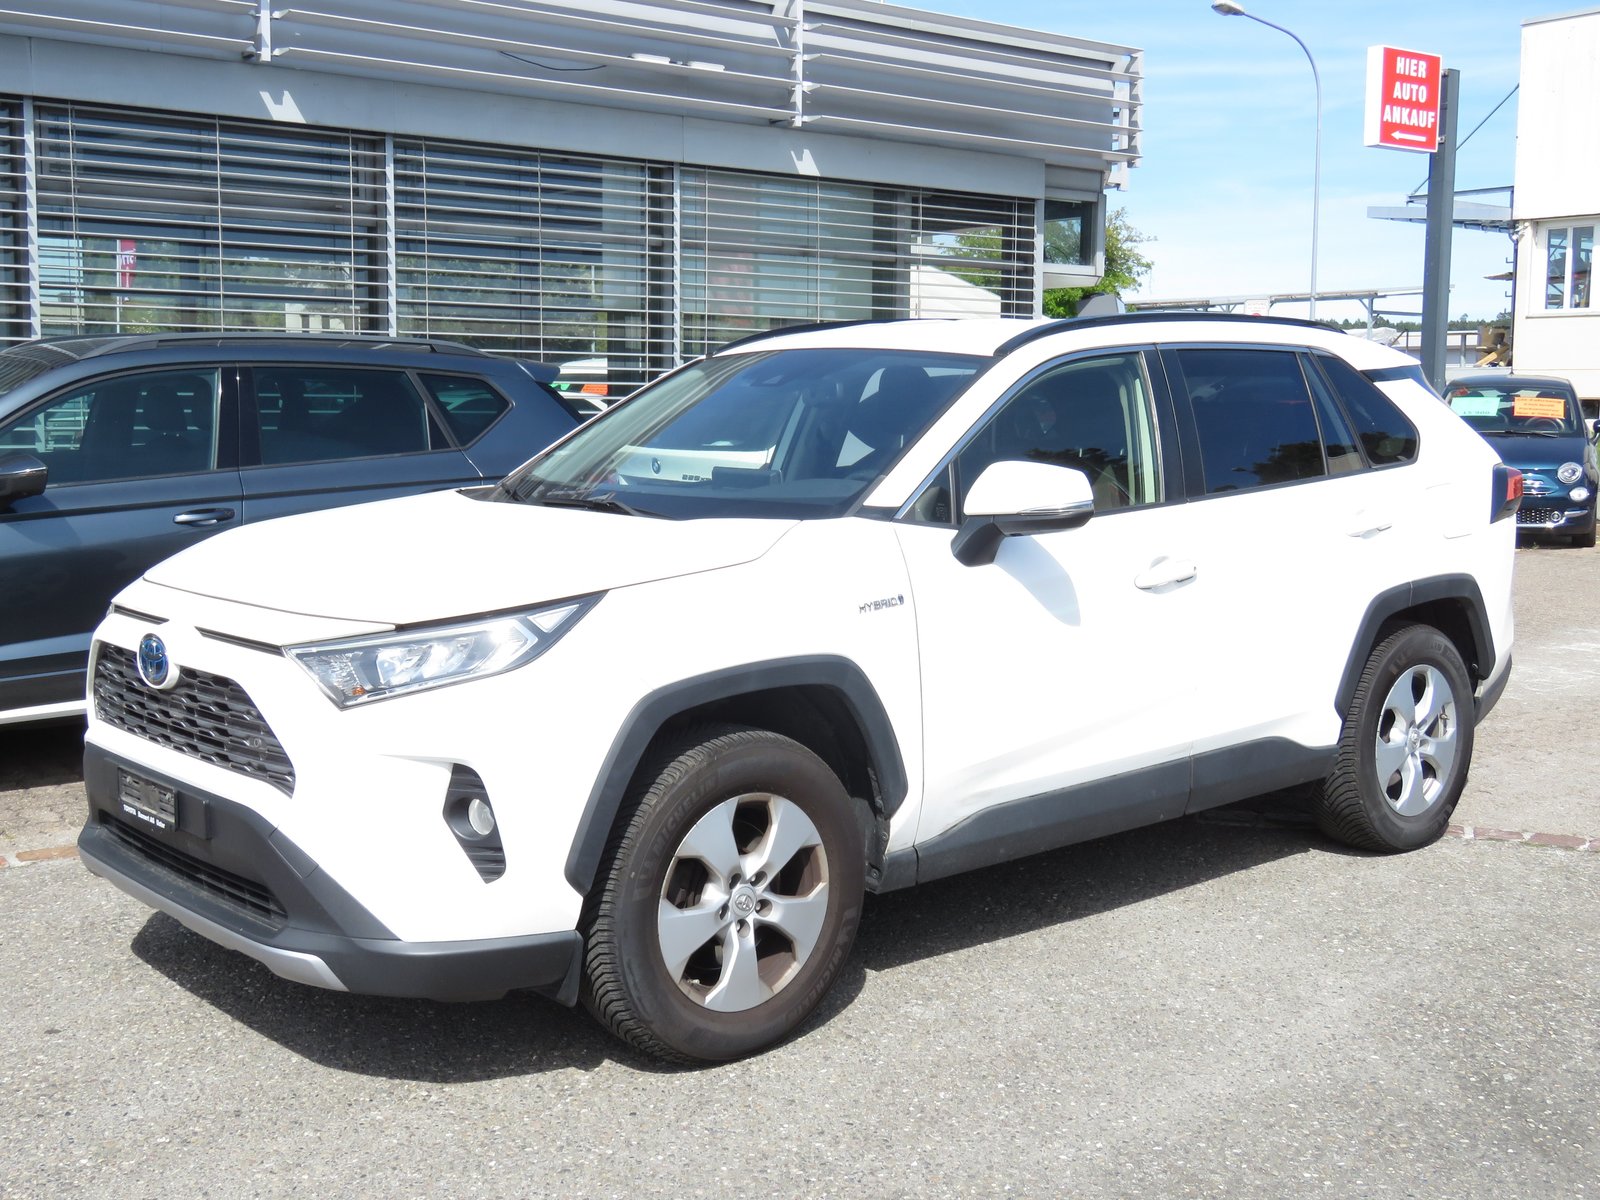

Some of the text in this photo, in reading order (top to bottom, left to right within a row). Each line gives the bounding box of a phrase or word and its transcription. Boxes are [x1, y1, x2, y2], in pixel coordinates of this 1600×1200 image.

[1396, 56, 1427, 78] HIER
[1393, 81, 1427, 103] AUTO
[1383, 104, 1436, 128] ANKAUF
[859, 597, 898, 614] HYBRID
